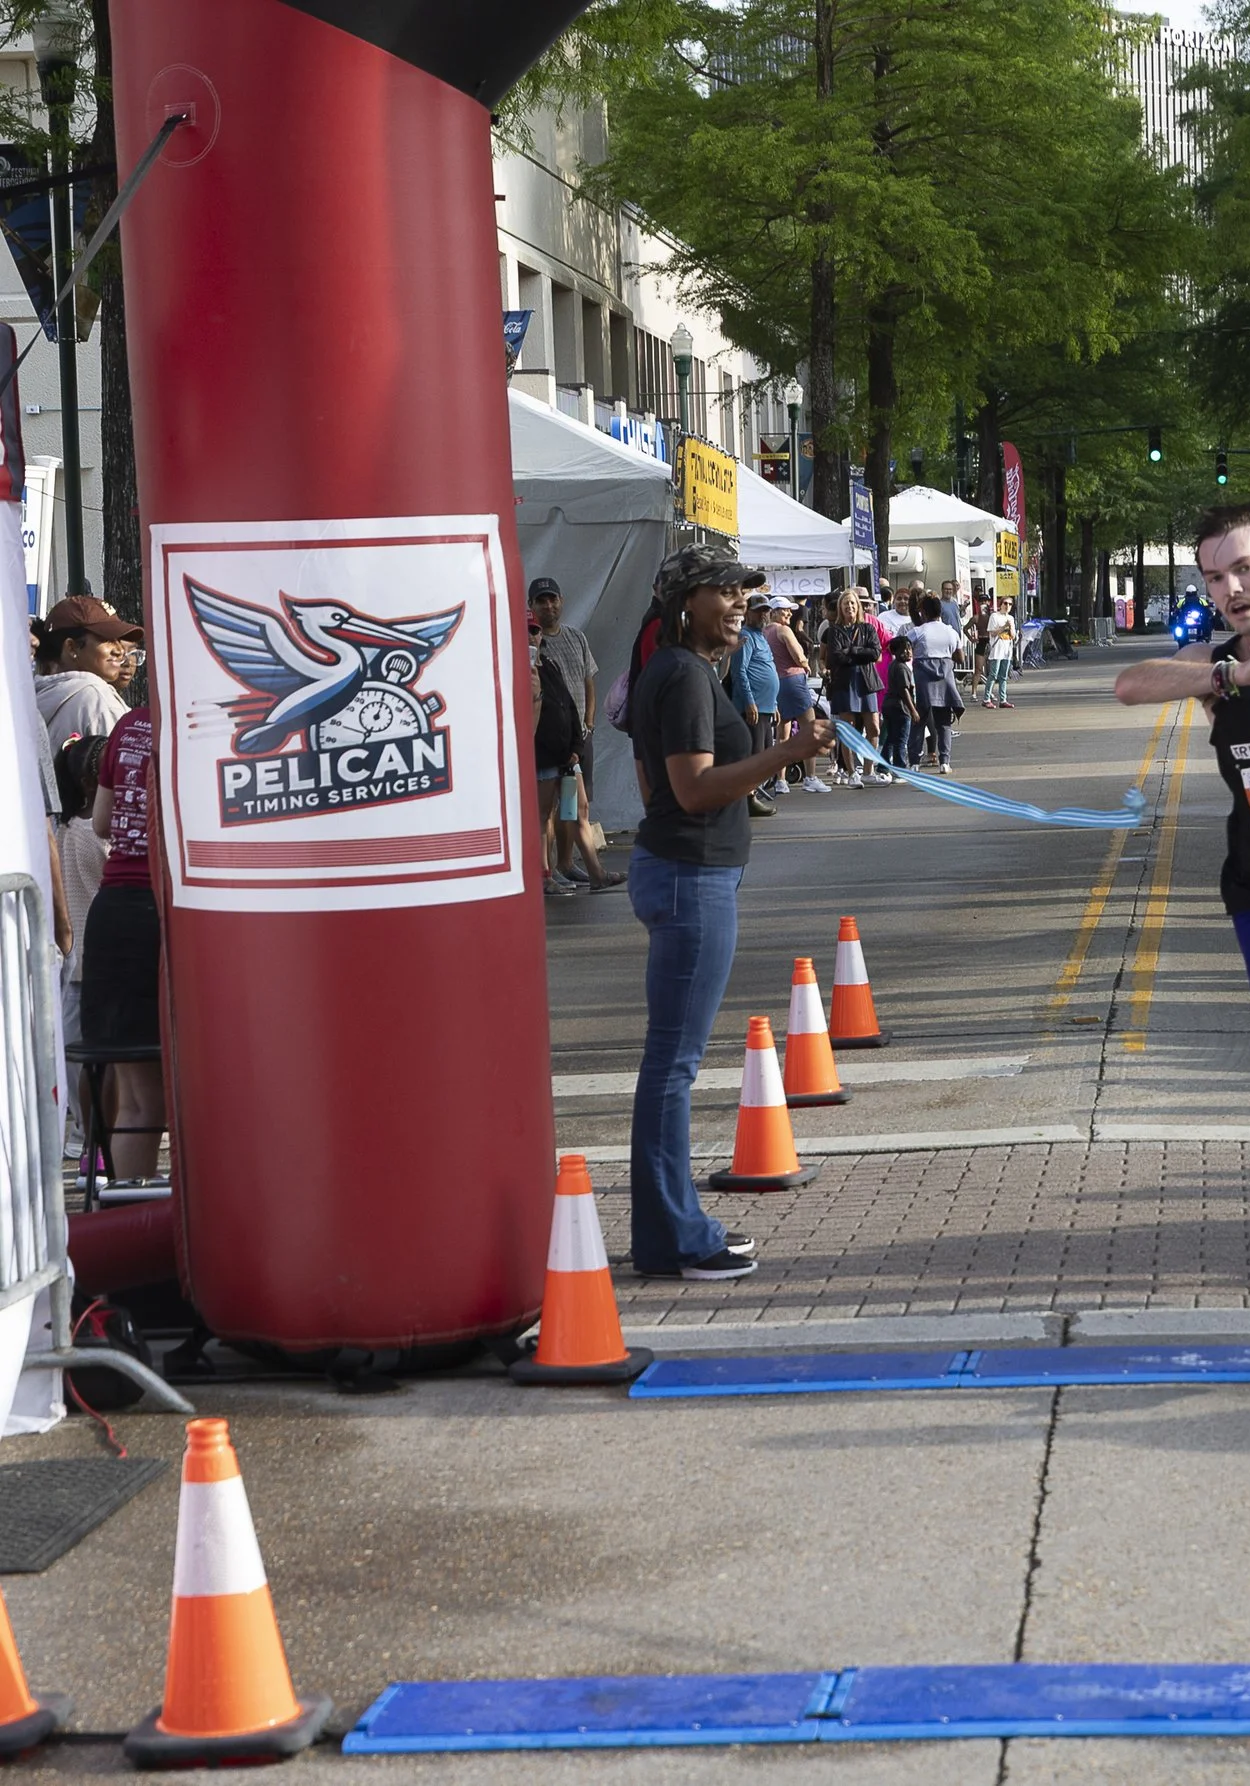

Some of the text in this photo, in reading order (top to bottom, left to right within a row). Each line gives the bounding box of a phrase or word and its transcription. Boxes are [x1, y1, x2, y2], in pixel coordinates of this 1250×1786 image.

[1160, 25, 1236, 57] HORIZON
[504, 321, 523, 334] Cola
[224, 735, 445, 800] PELICAN
[243, 775, 431, 815] TIMING SERVICES
